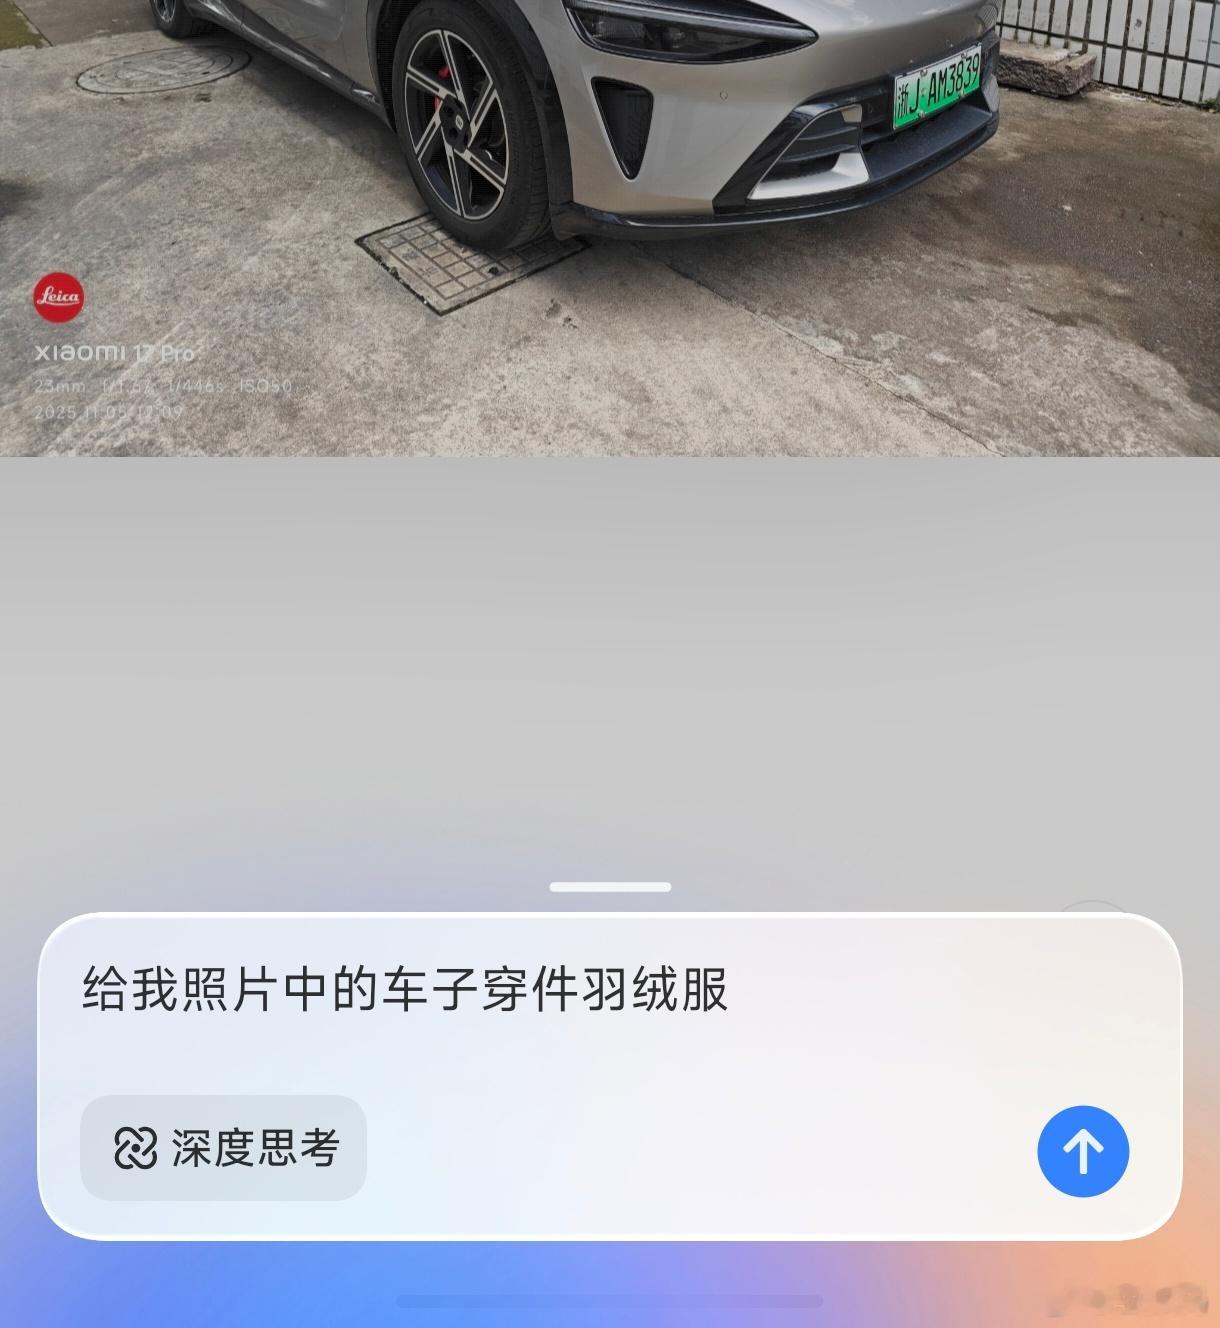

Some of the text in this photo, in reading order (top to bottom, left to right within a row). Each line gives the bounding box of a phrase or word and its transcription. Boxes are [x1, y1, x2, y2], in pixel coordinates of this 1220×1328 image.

[82, 964, 729, 1014] 给我照片中的车子穿件羽绒服
[172, 1126, 340, 1168] 深度思考
